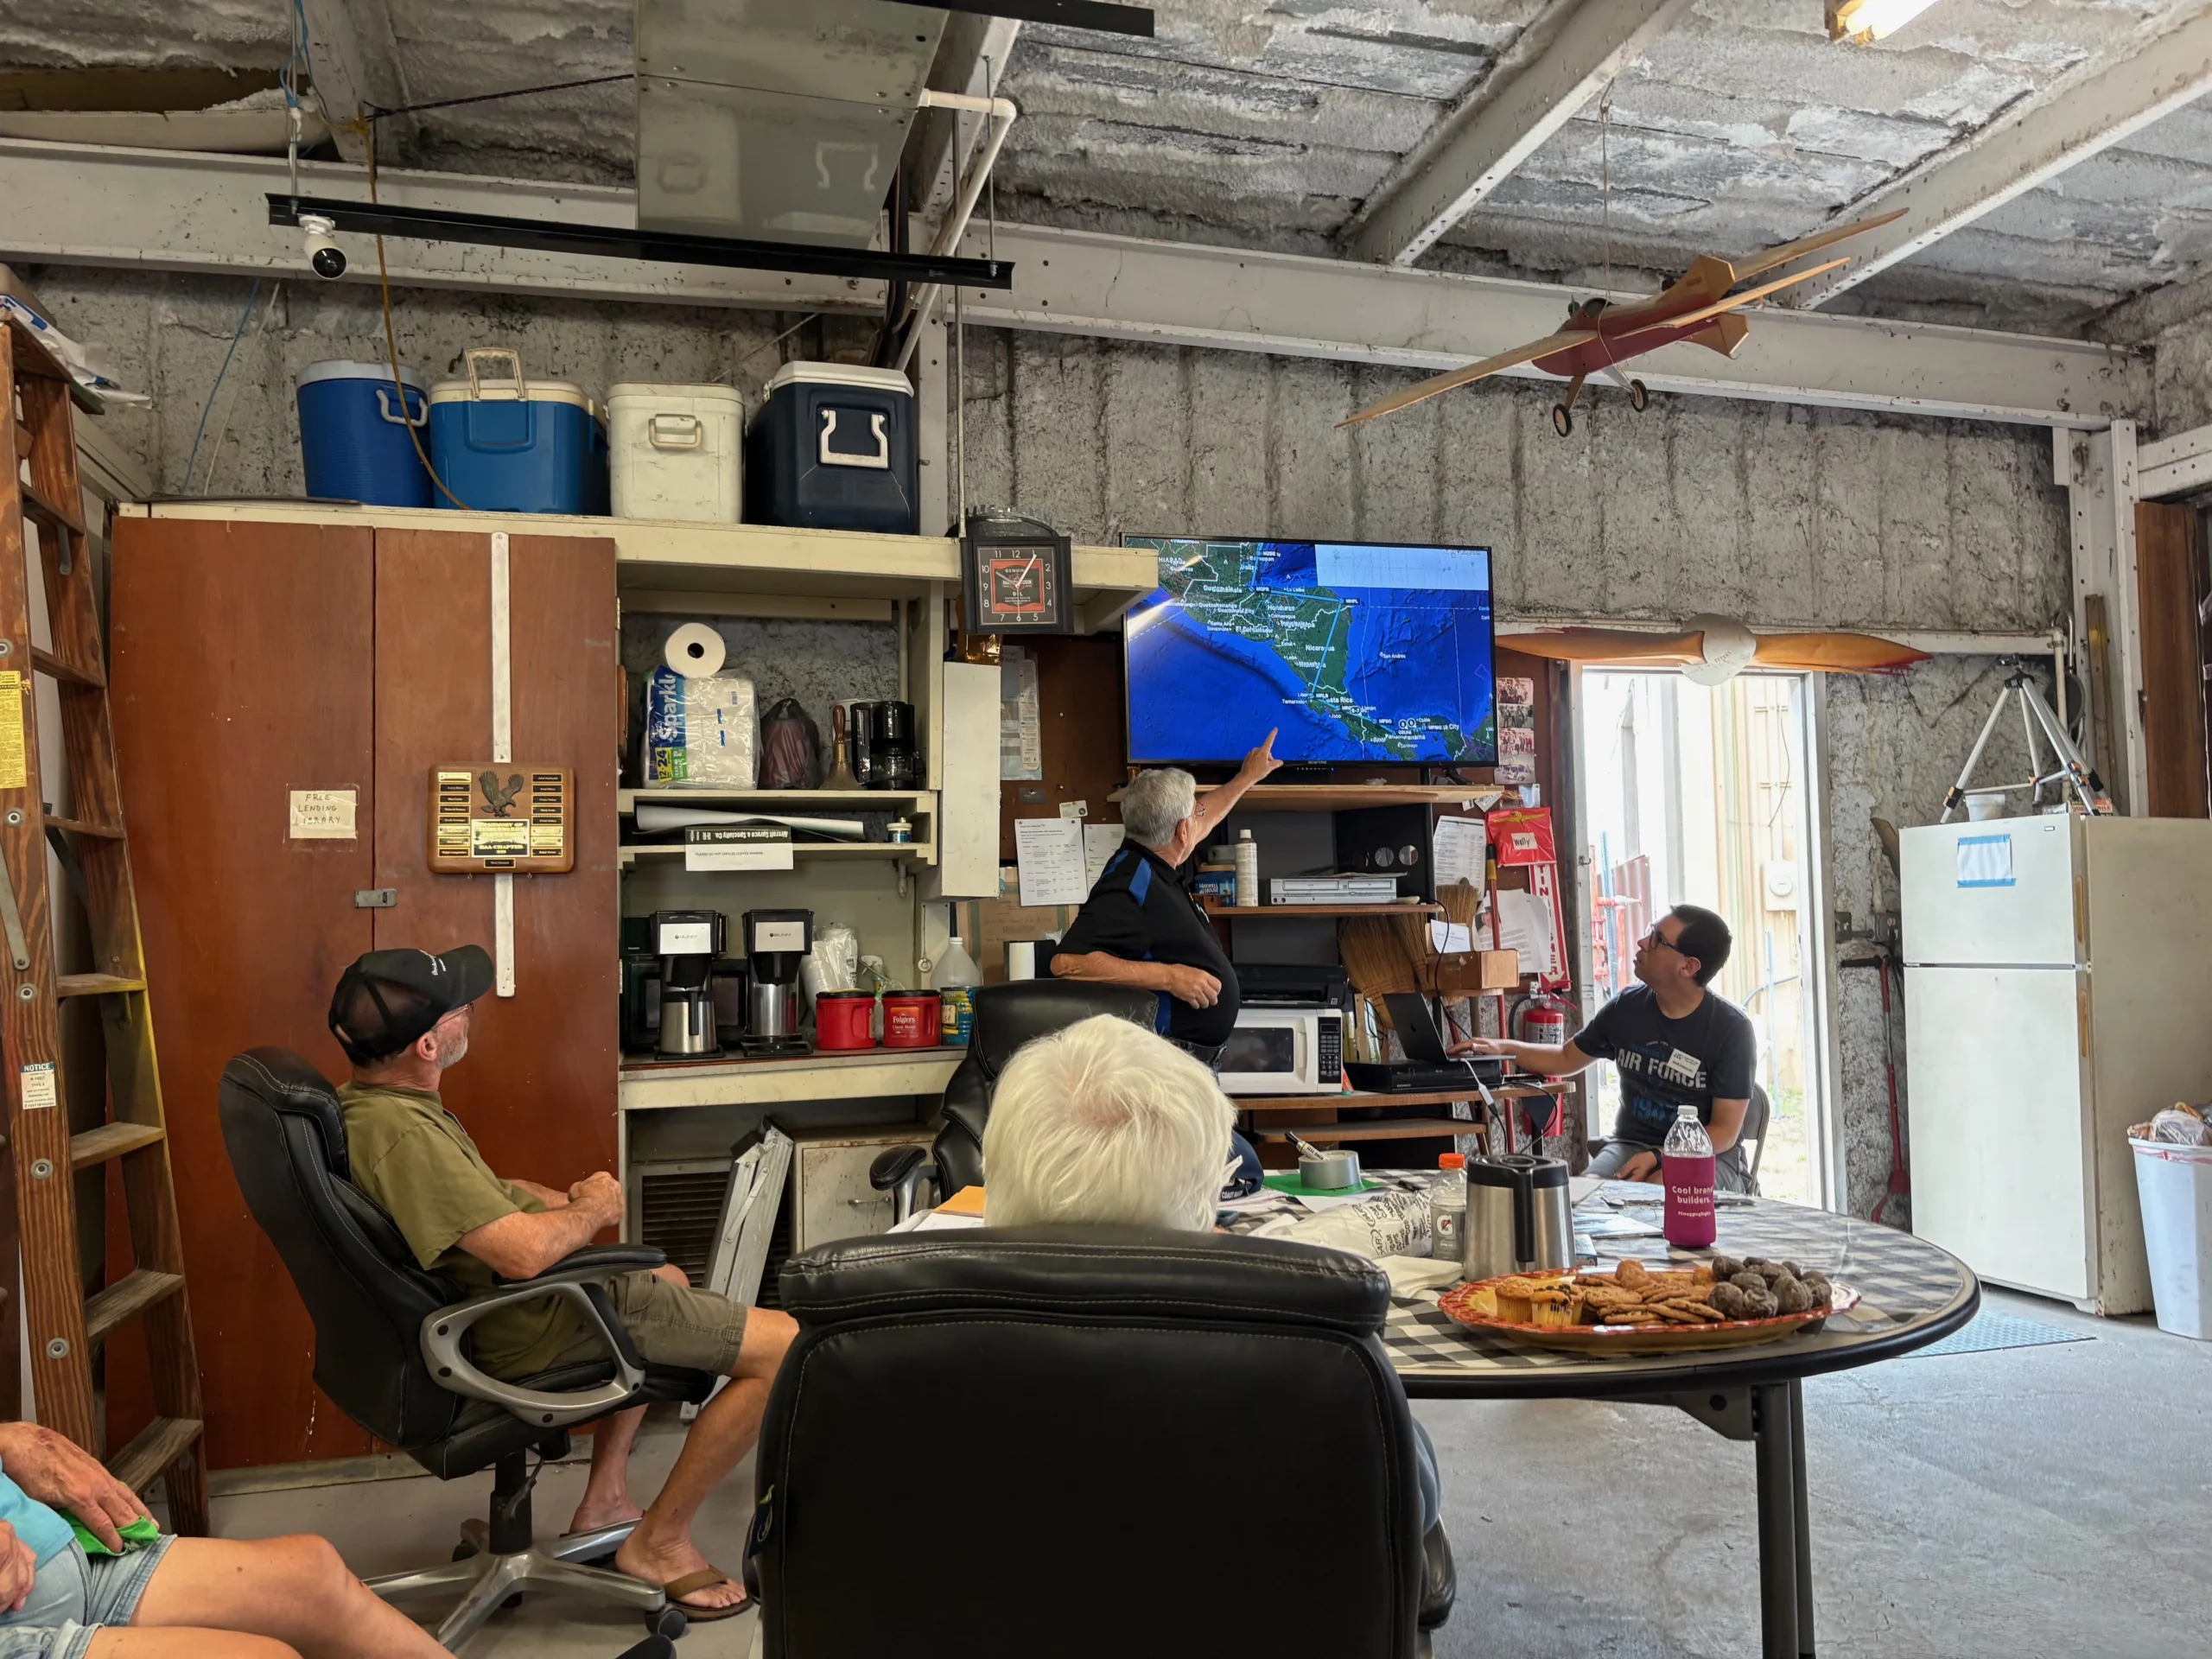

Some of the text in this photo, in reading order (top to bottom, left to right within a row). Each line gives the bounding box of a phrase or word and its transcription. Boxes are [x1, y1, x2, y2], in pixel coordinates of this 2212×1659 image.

[1012, 550, 1020, 558] 12
[982, 565, 990, 574] 10
[1045, 563, 1051, 572] 2
[982, 582, 988, 591] 9
[1046, 581, 1052, 589] 3
[983, 599, 990, 607] 8
[1000, 613, 1005, 622] 7
[1016, 613, 1021, 622] 6
[305, 793, 332, 802] FREE
[298, 804, 337, 813] LENDING
[292, 817, 340, 826] LIBRARY
[893, 1016, 916, 1025] Folgers
[23, 1063, 51, 1072] NOTICE
[1618, 1048, 1643, 1071] AIR
[1647, 1058, 1707, 1089] FORCE
[1672, 1185, 1691, 1194] Cool
